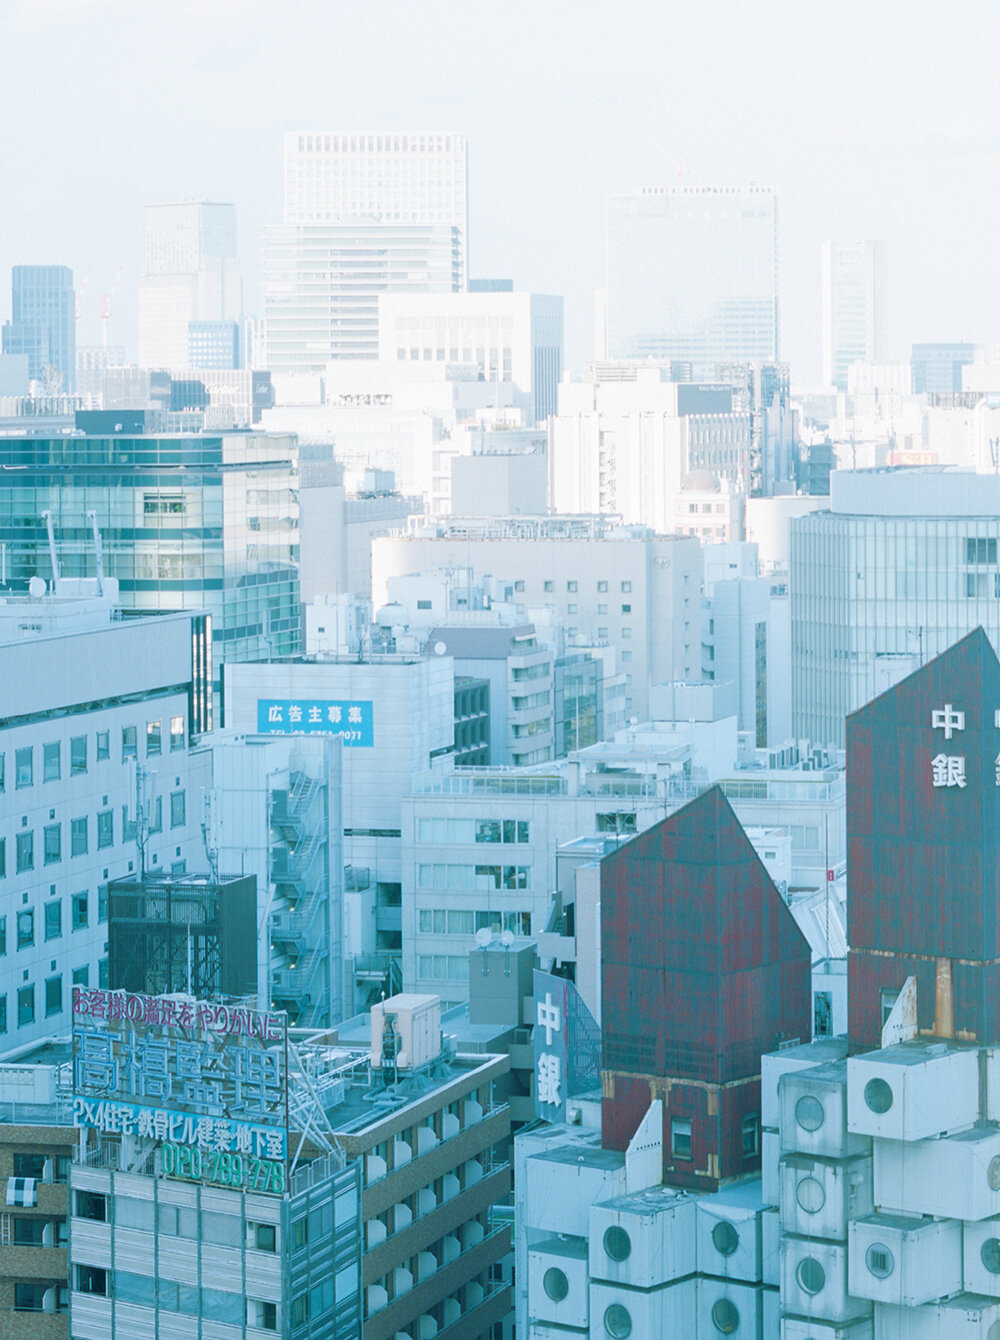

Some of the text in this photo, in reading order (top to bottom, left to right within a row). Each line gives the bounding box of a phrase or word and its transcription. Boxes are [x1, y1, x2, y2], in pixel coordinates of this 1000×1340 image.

[268, 705, 363, 723] 広告主募集
[931, 704, 967, 788] 中銀
[537, 992, 562, 1108] 中銀
